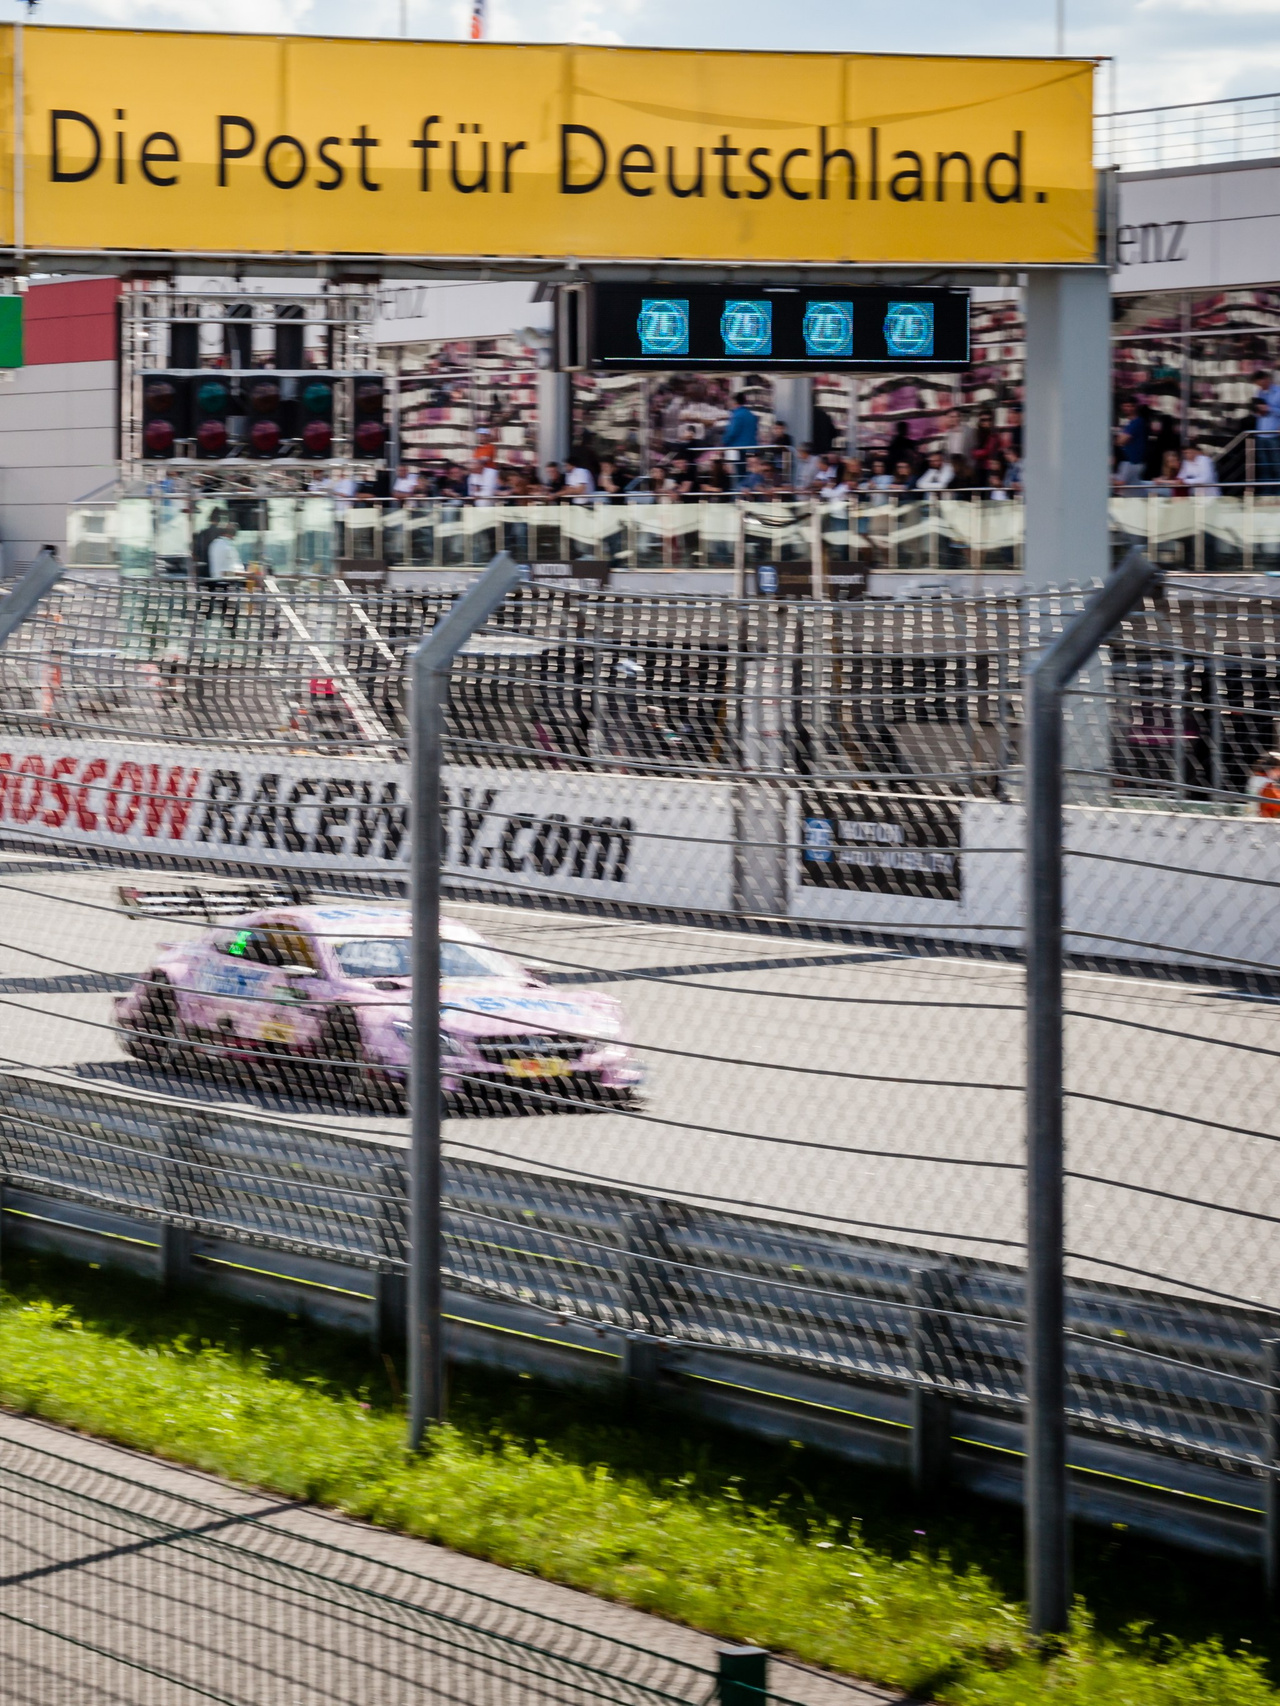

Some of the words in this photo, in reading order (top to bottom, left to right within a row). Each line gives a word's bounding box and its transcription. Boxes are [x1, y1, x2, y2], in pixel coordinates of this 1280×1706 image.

[48, 108, 181, 187] Die
[216, 114, 382, 191] Post
[410, 114, 527, 194] für
[557, 123, 1049, 204] Deutschland.
[1116, 221, 1187, 266] enz
[197, 768, 637, 882] RACEWY.com
